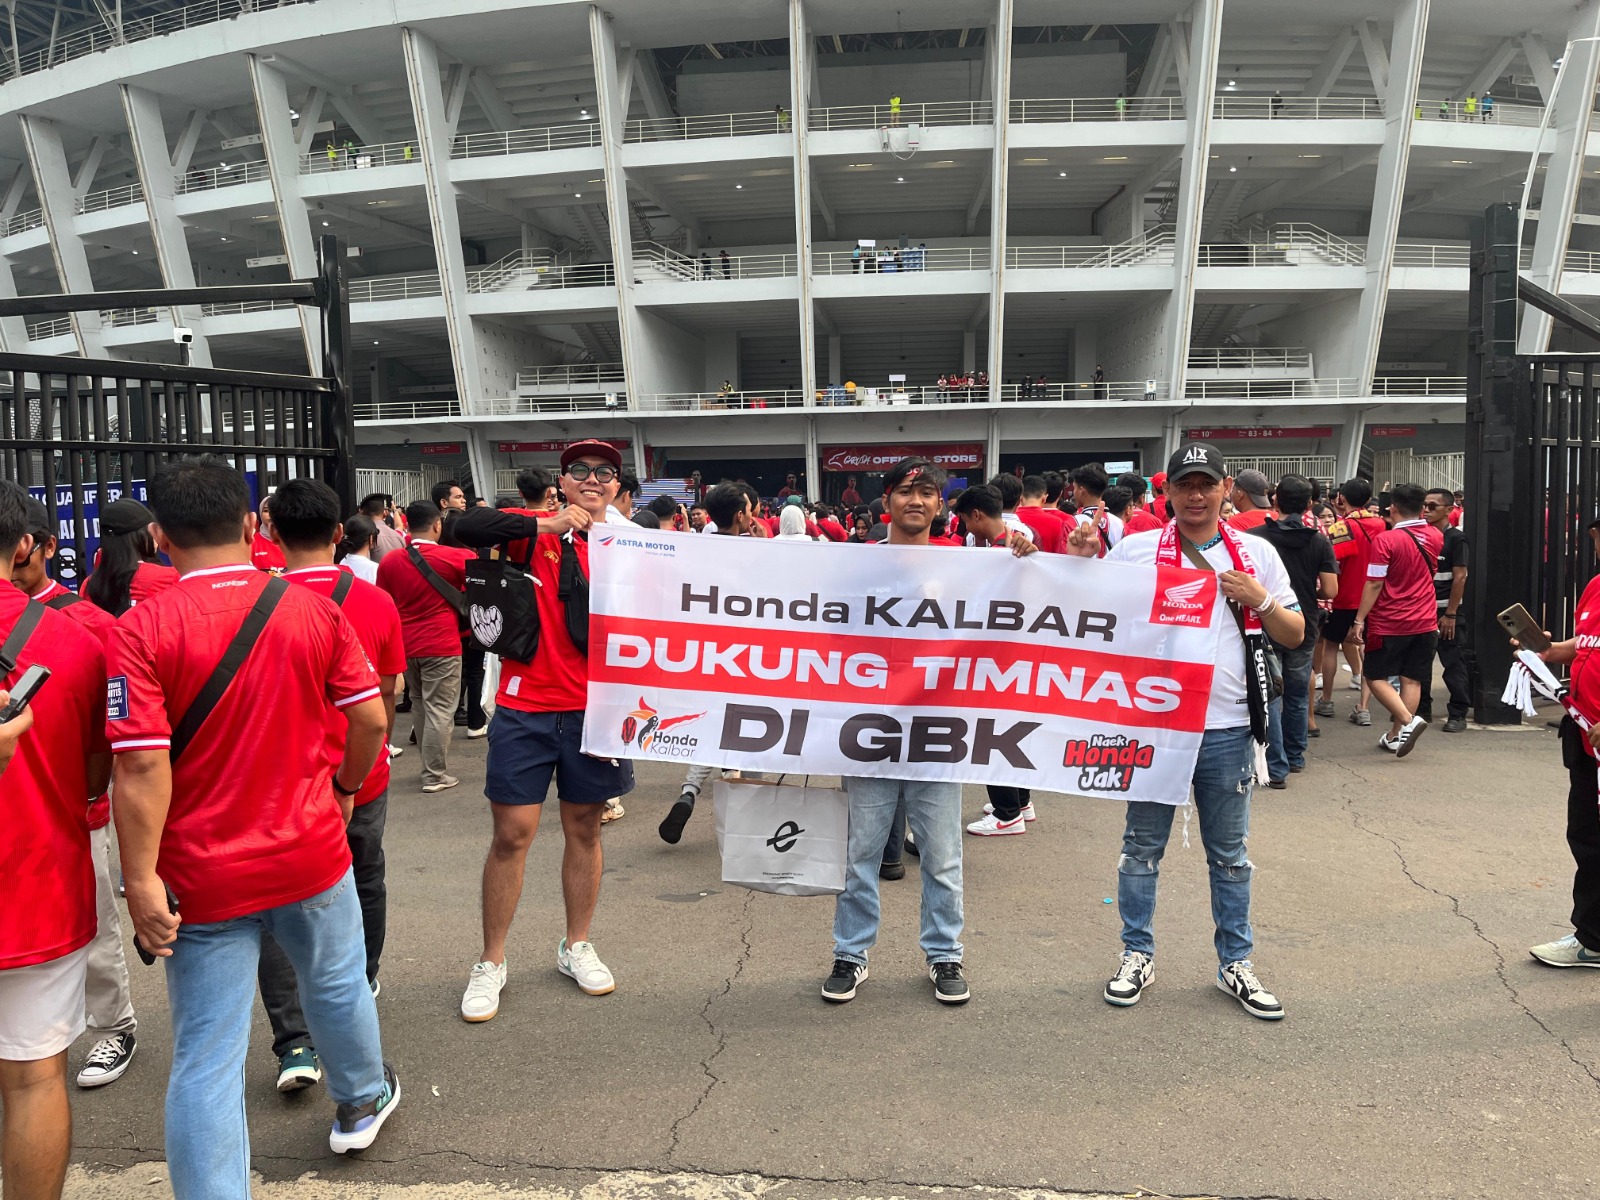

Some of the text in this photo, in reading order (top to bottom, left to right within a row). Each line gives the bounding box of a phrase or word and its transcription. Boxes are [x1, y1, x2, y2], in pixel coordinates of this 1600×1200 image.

[933, 455, 977, 463] STORE
[616, 538, 675, 551] ASTRA MOTOR
[1162, 600, 1204, 609] HONDA
[681, 583, 1117, 642] Honda KALBAR
[1159, 614, 1174, 622] One
[605, 632, 1181, 713] DUKUNG TIMNAS
[652, 731, 698, 746] Honda
[719, 702, 1044, 771] DI GBK
[1091, 735, 1126, 747] Naek
[650, 742, 695, 758] Kalbar
[1064, 740, 1154, 767] Honda
[1080, 766, 1132, 789] Jak!
